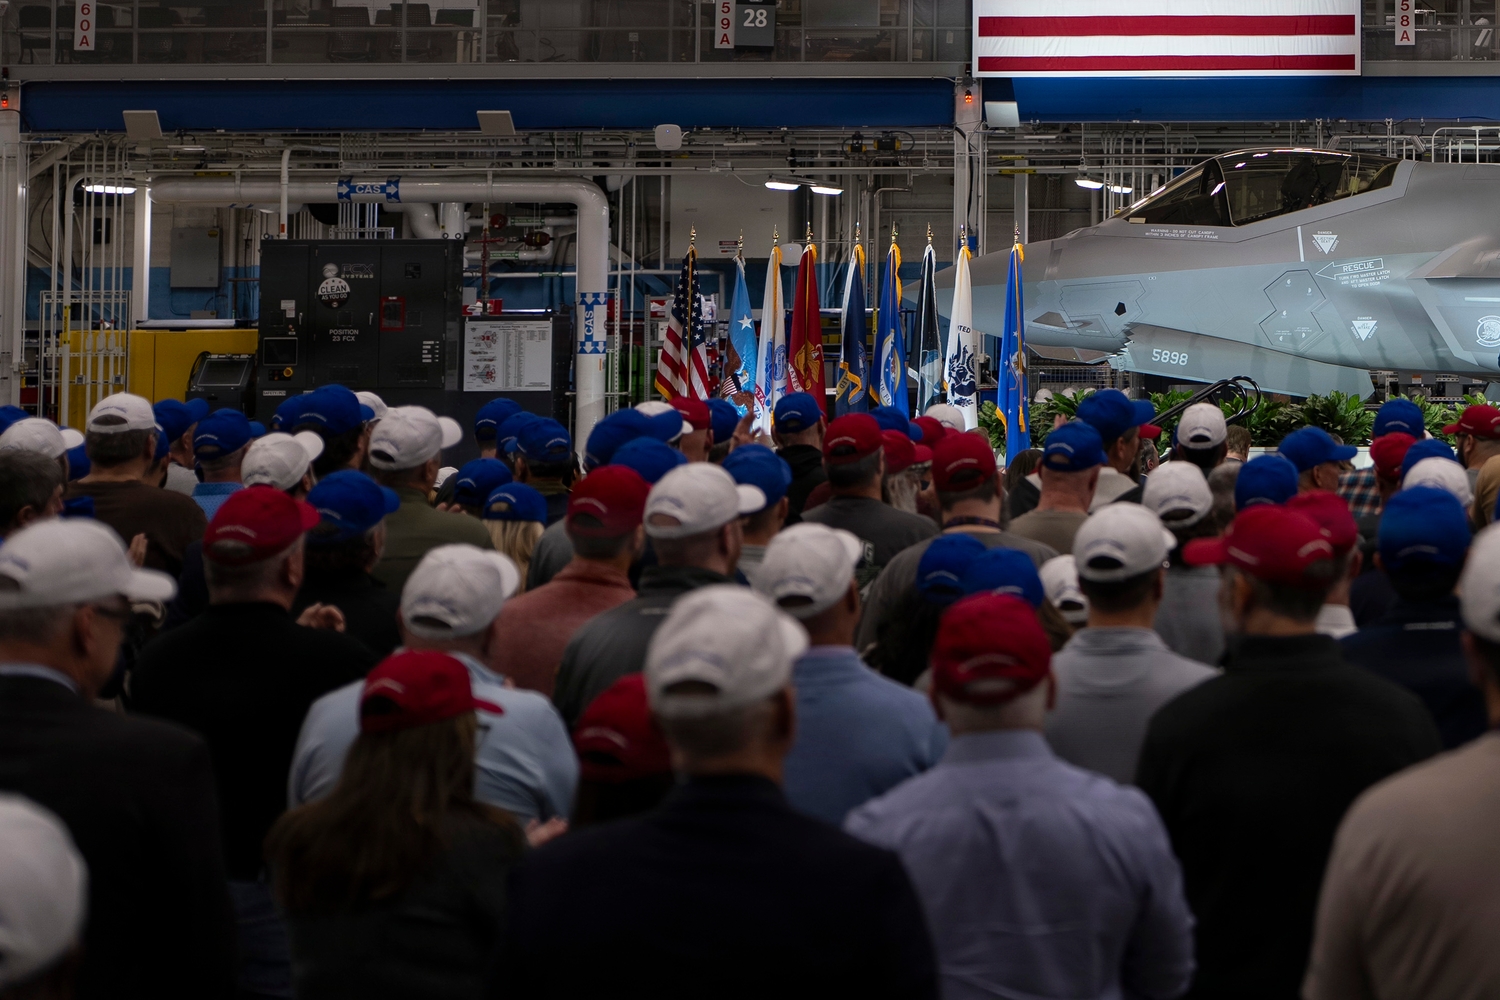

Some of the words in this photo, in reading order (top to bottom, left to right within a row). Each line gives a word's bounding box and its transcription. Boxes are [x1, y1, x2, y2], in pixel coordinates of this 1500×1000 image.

[743, 8, 768, 28] 28
[355, 185, 381, 194] CAS
[1342, 261, 1374, 272] RESCUE
[320, 285, 347, 294] CLEAN
[585, 310, 594, 336] CAS
[1152, 348, 1188, 366] 5898
